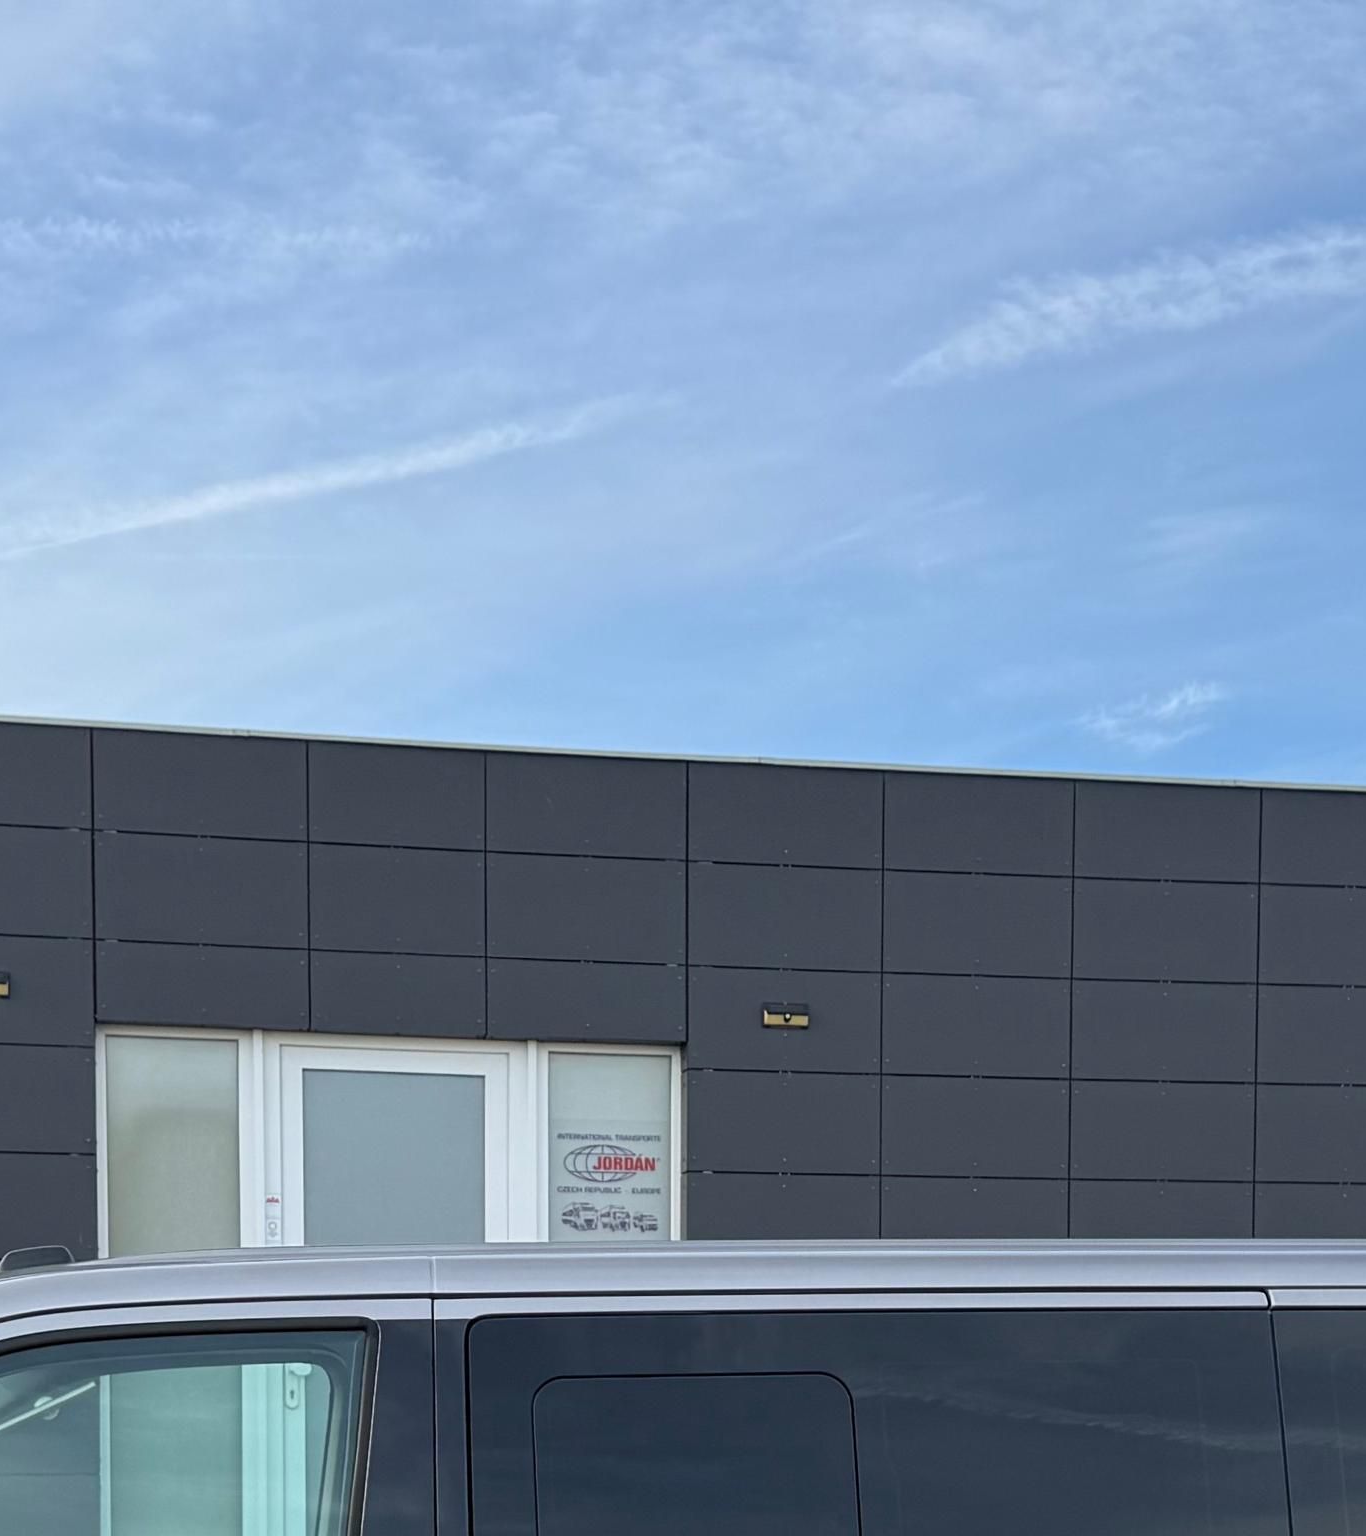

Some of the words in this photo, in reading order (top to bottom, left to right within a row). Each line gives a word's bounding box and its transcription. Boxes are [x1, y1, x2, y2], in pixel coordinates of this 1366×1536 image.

[557, 1133, 612, 1142] INTERNATIONAL
[593, 1153, 655, 1171] JORDÁN
[557, 1186, 583, 1194] CZECH
[584, 1187, 621, 1195] REPUBLIC
